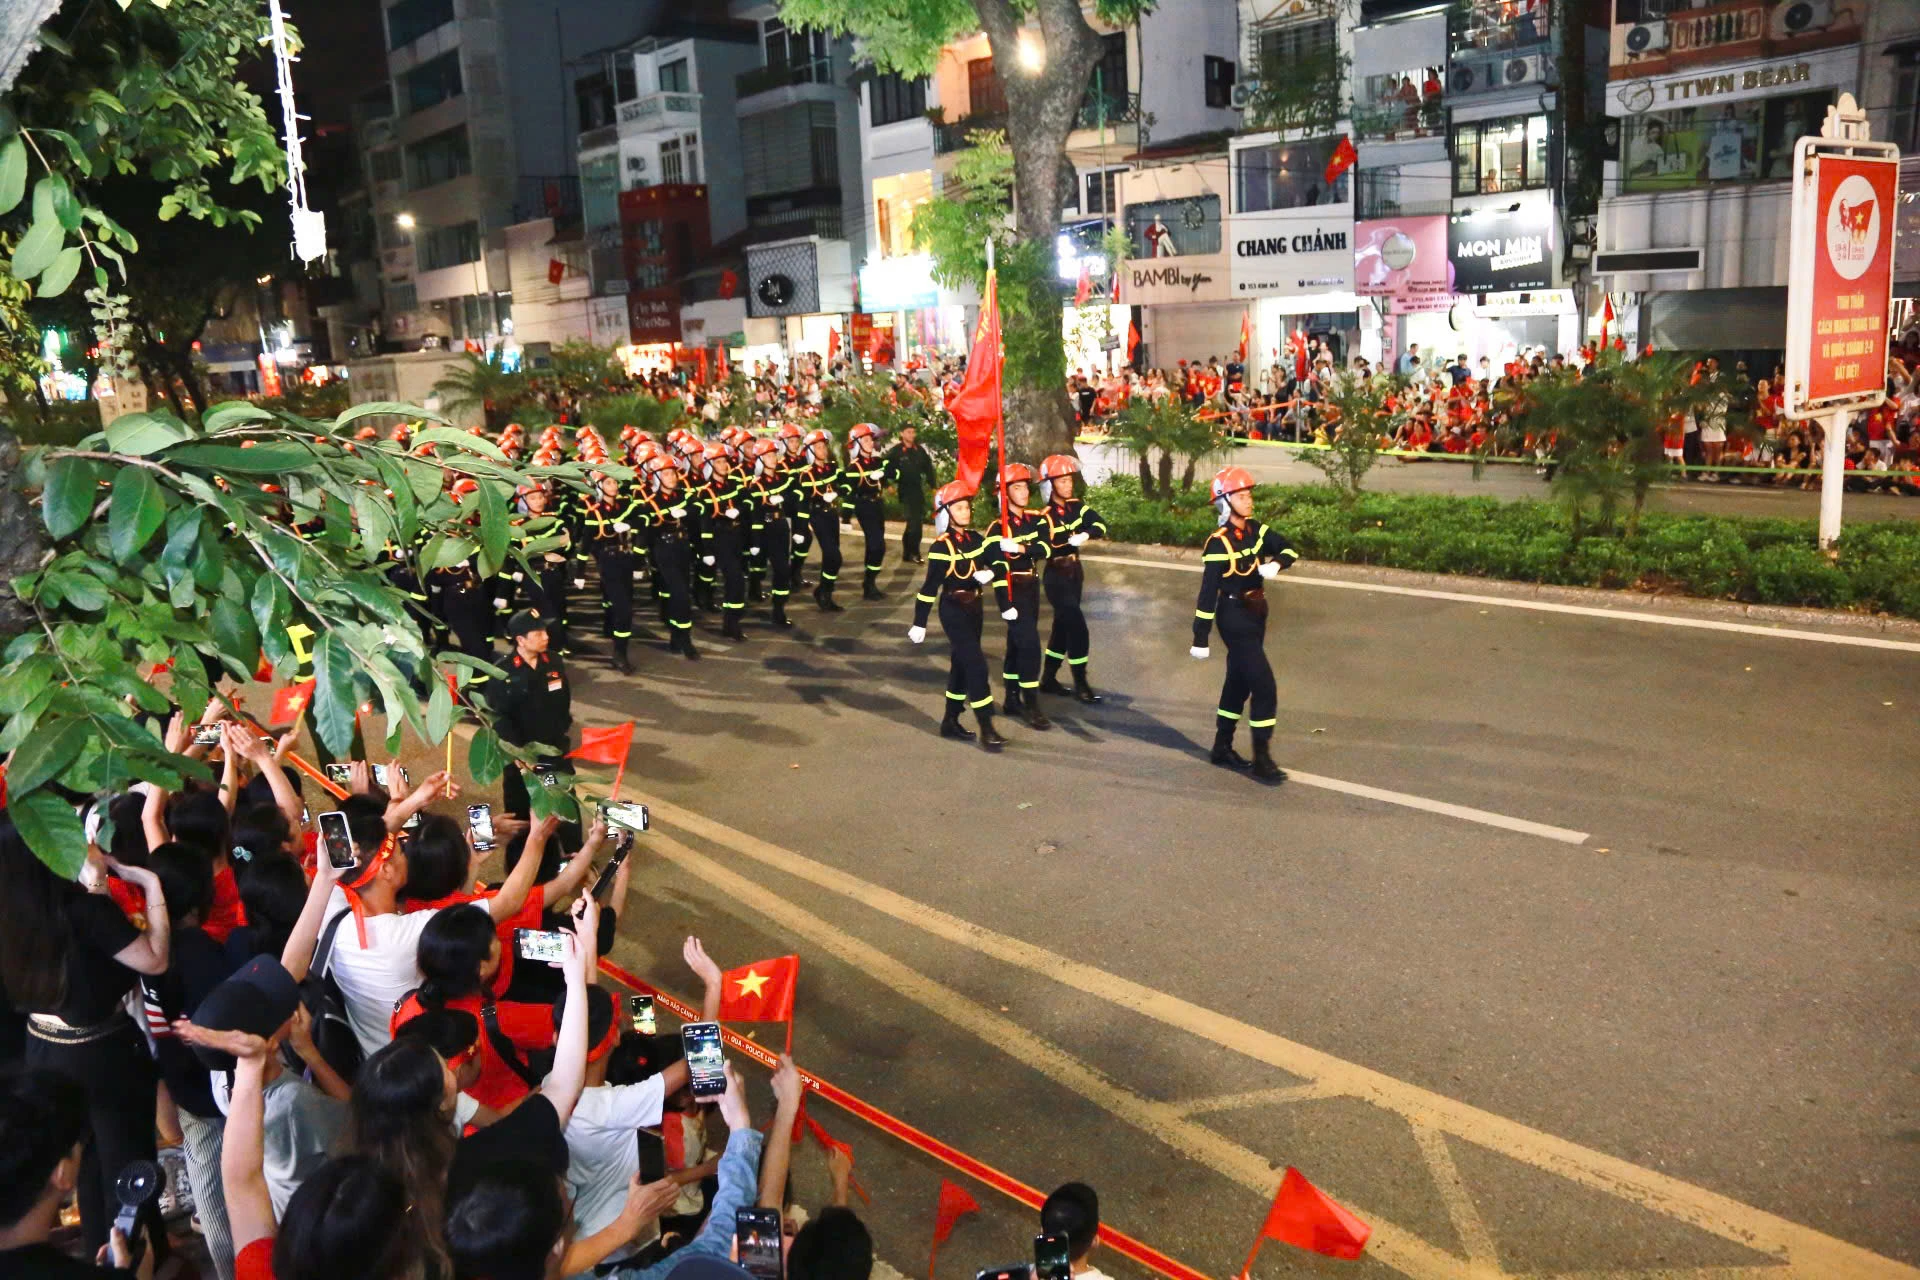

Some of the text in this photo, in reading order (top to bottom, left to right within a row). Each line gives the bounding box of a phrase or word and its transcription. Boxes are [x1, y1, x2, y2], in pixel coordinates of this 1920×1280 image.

[1665, 62, 1810, 101] TTWN BEAR
[1236, 227, 1347, 257] CHANG CHẢNH
[1457, 235, 1542, 258] MON MIN
[1133, 267, 1180, 288] BAMBI
[730, 1036, 742, 1047] QUA
[745, 1044, 764, 1060] POLICE
[764, 1055, 777, 1067] LINE
